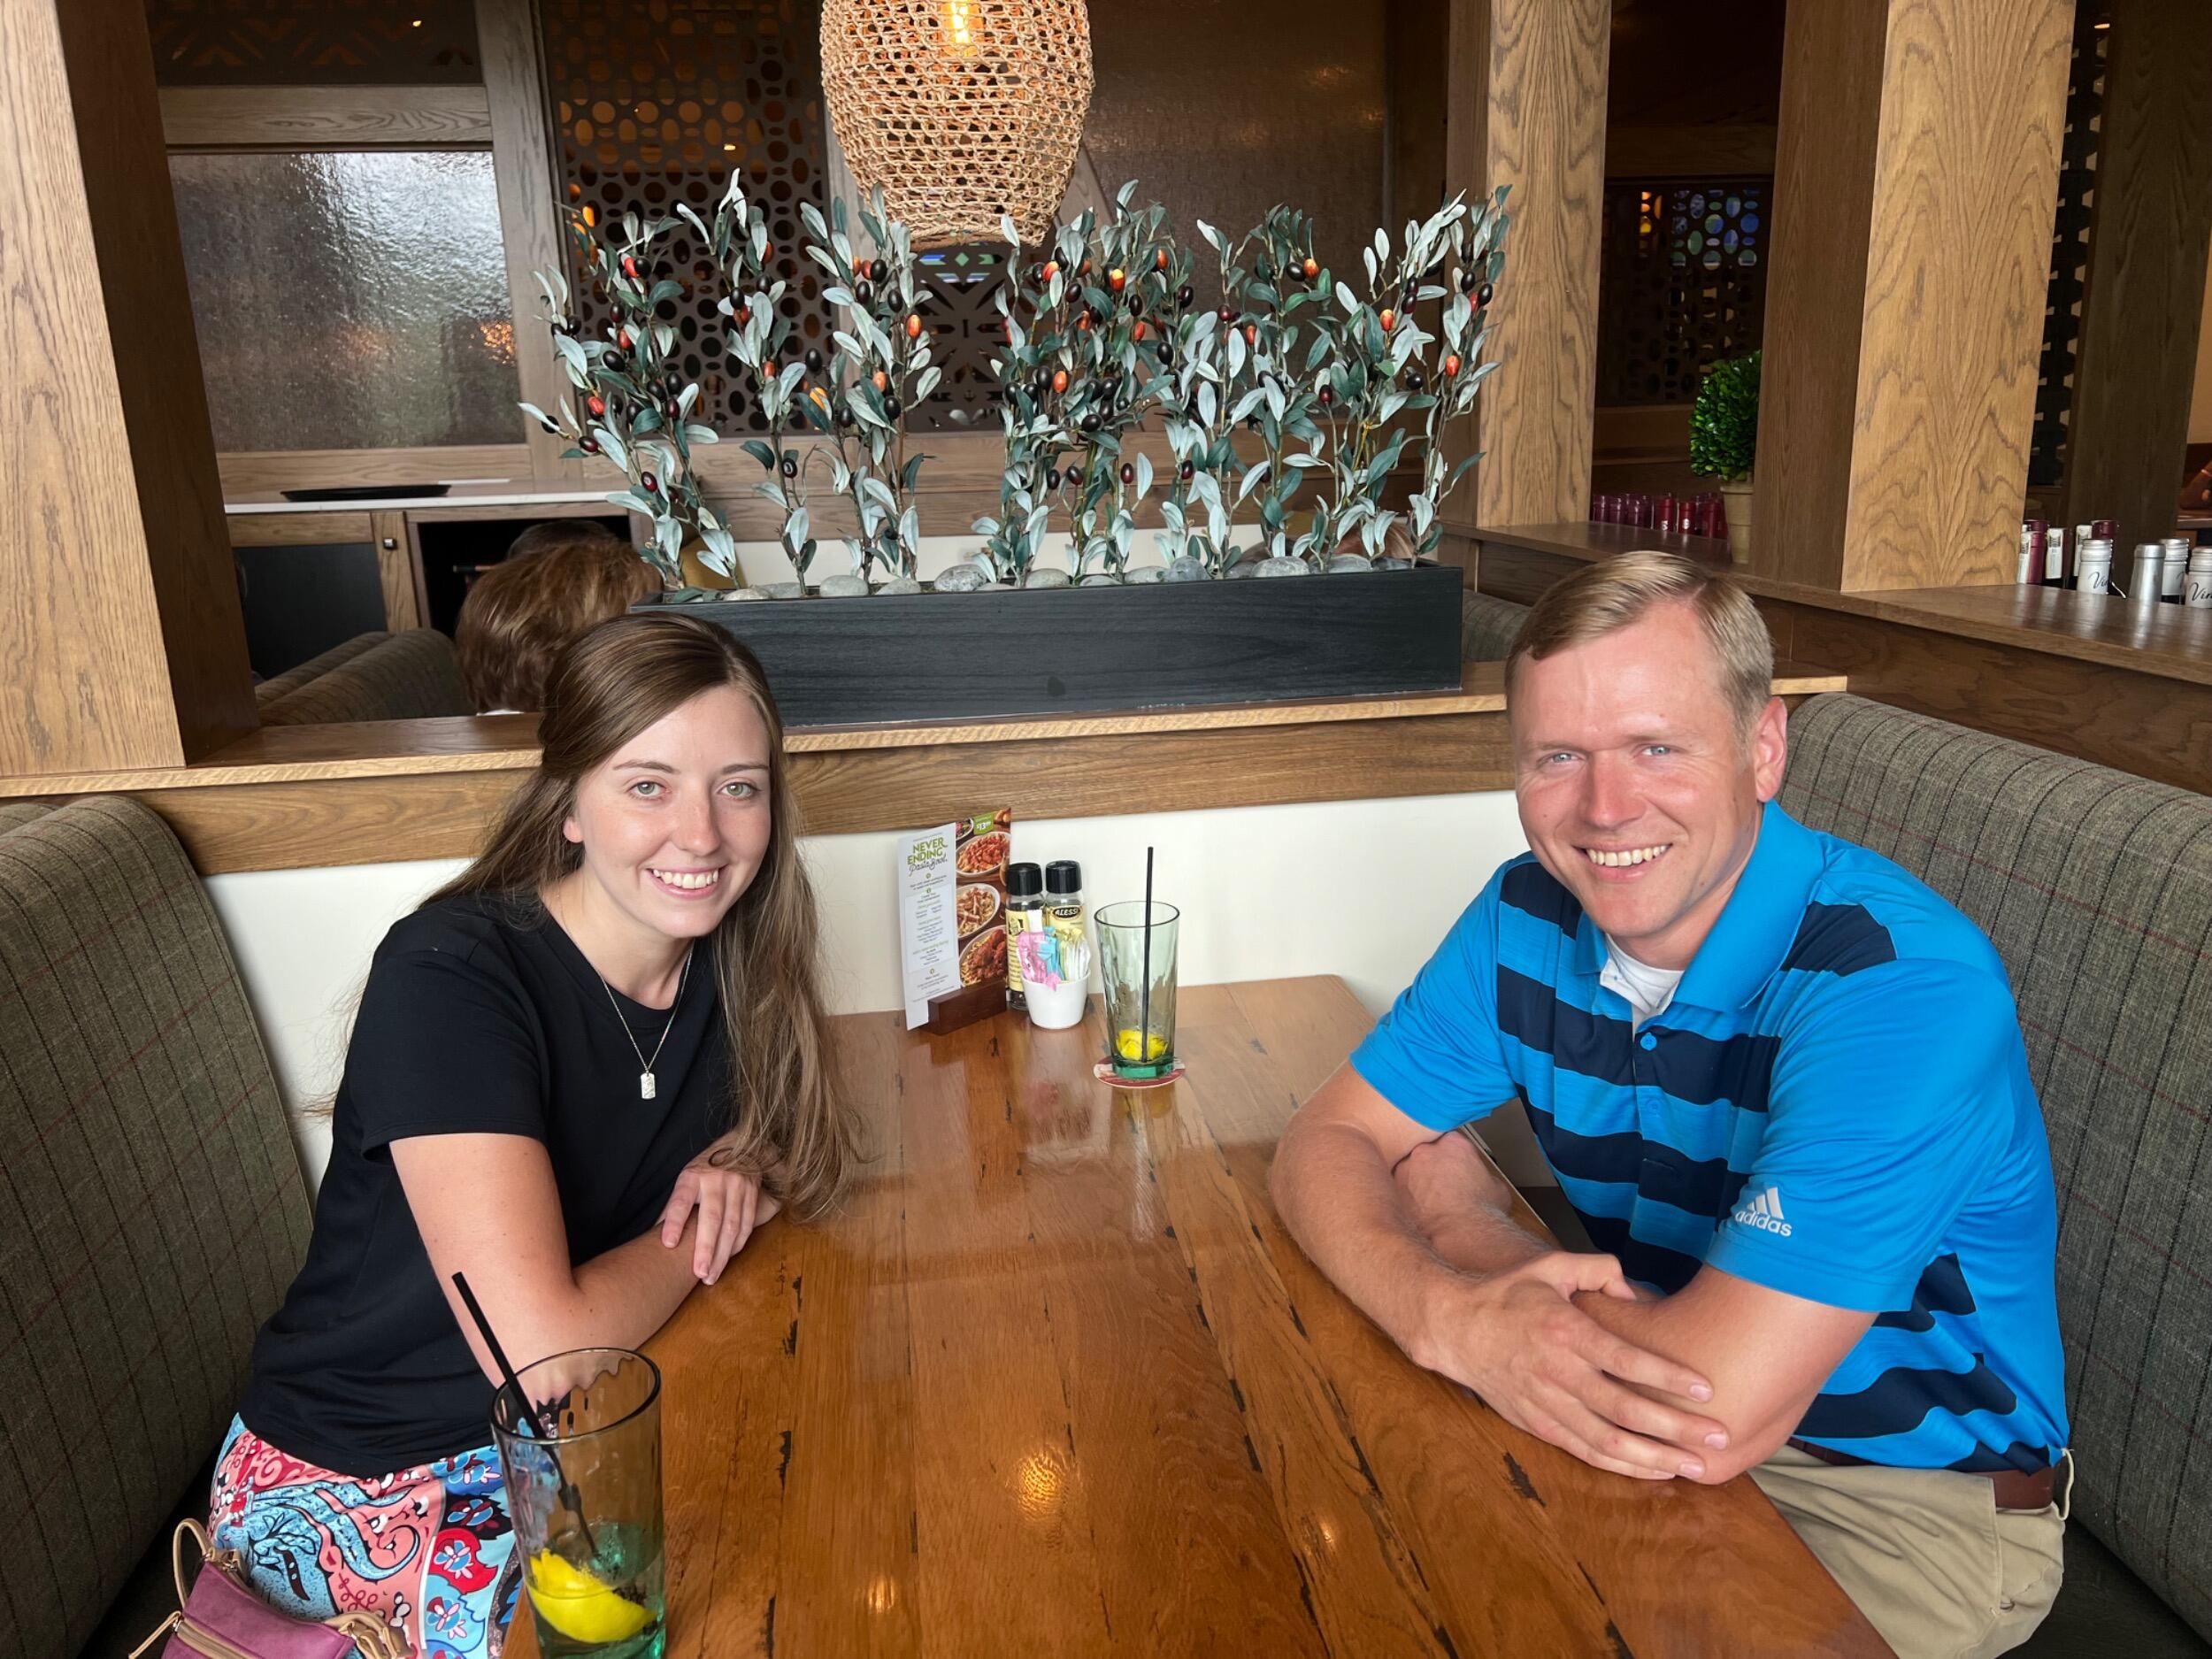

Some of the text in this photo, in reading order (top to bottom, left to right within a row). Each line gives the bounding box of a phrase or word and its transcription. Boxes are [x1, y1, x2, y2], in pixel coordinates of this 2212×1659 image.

[913, 837, 948, 854] NEVER
[907, 847, 943, 865] ENDING
[1735, 1210, 1792, 1237] adidas
